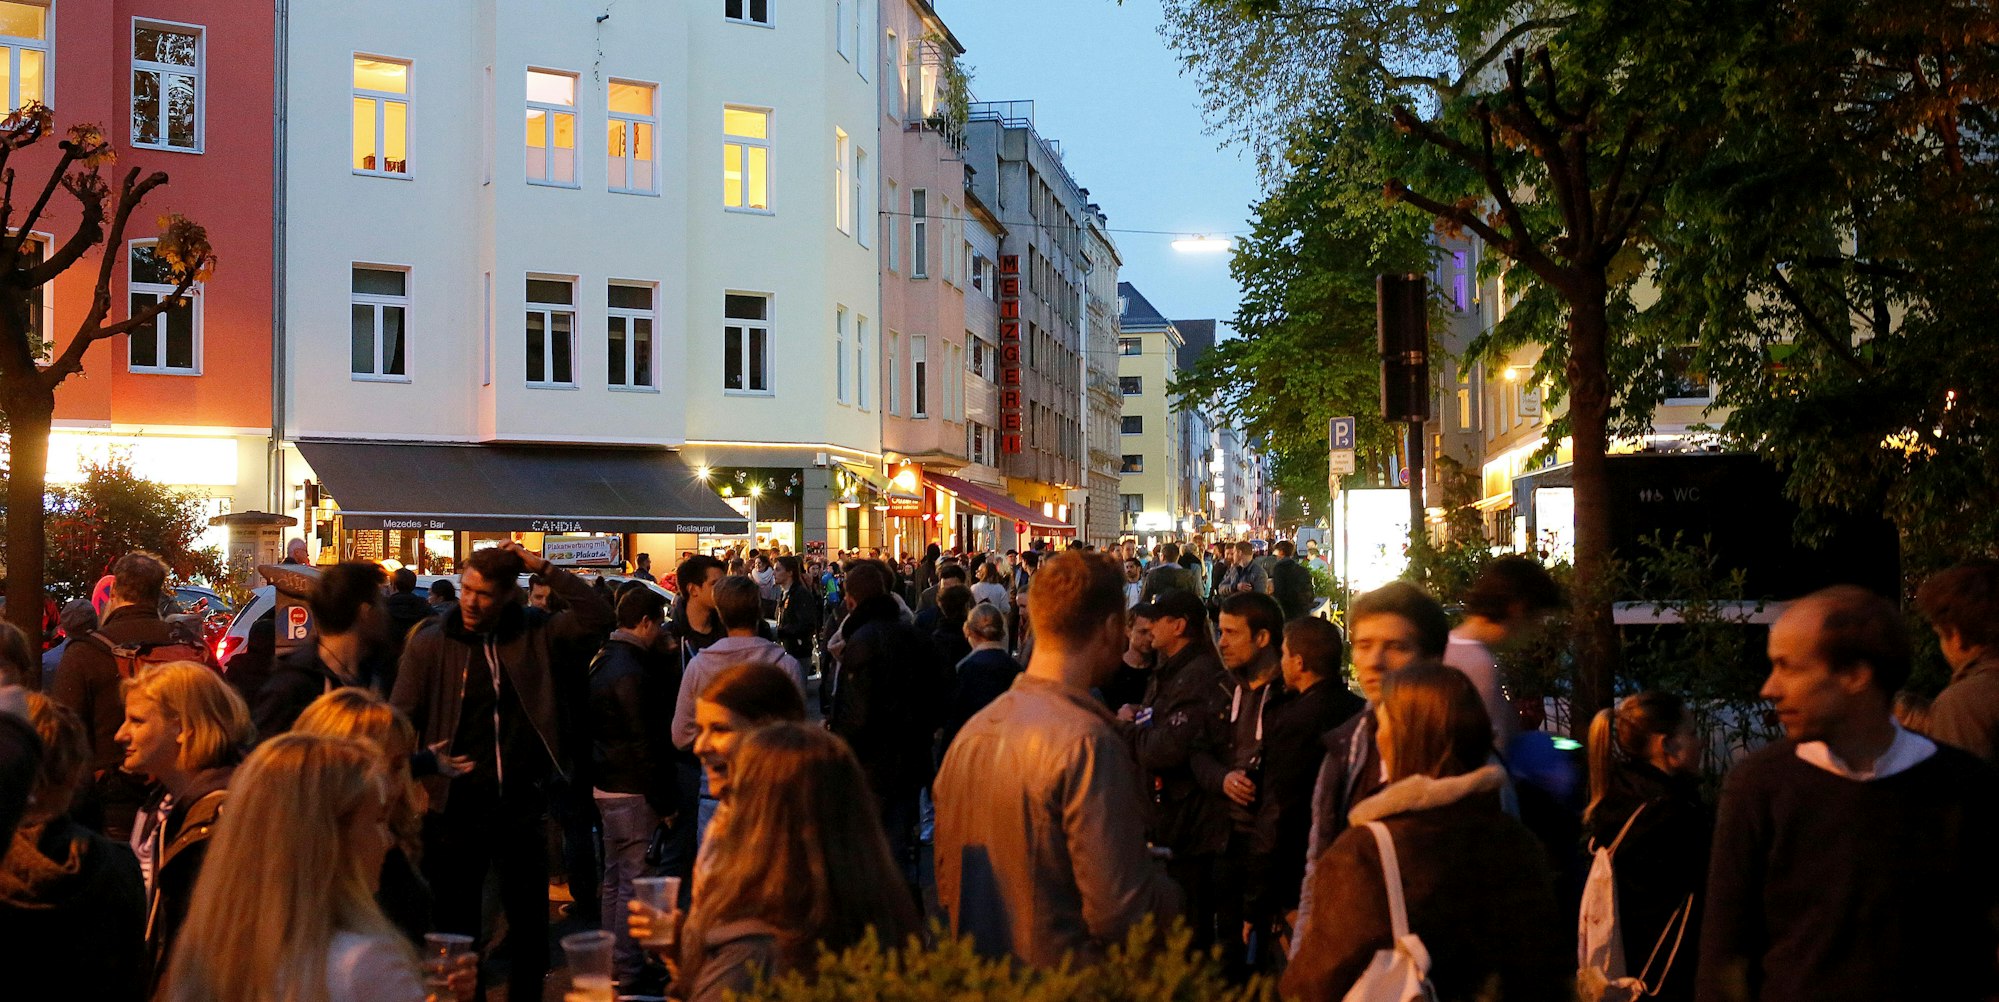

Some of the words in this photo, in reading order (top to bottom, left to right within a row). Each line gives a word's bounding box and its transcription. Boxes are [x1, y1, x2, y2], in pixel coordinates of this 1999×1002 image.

[1003, 258, 1018, 450] METZGEREI
[1335, 422, 1349, 446] P
[1672, 487, 1700, 502] WC
[383, 519, 422, 528] Mezedes
[429, 519, 445, 529] Bar
[531, 520, 583, 532] CANDIA
[676, 524, 716, 533] Restaurant
[547, 542, 593, 550] Plakatwerbung
